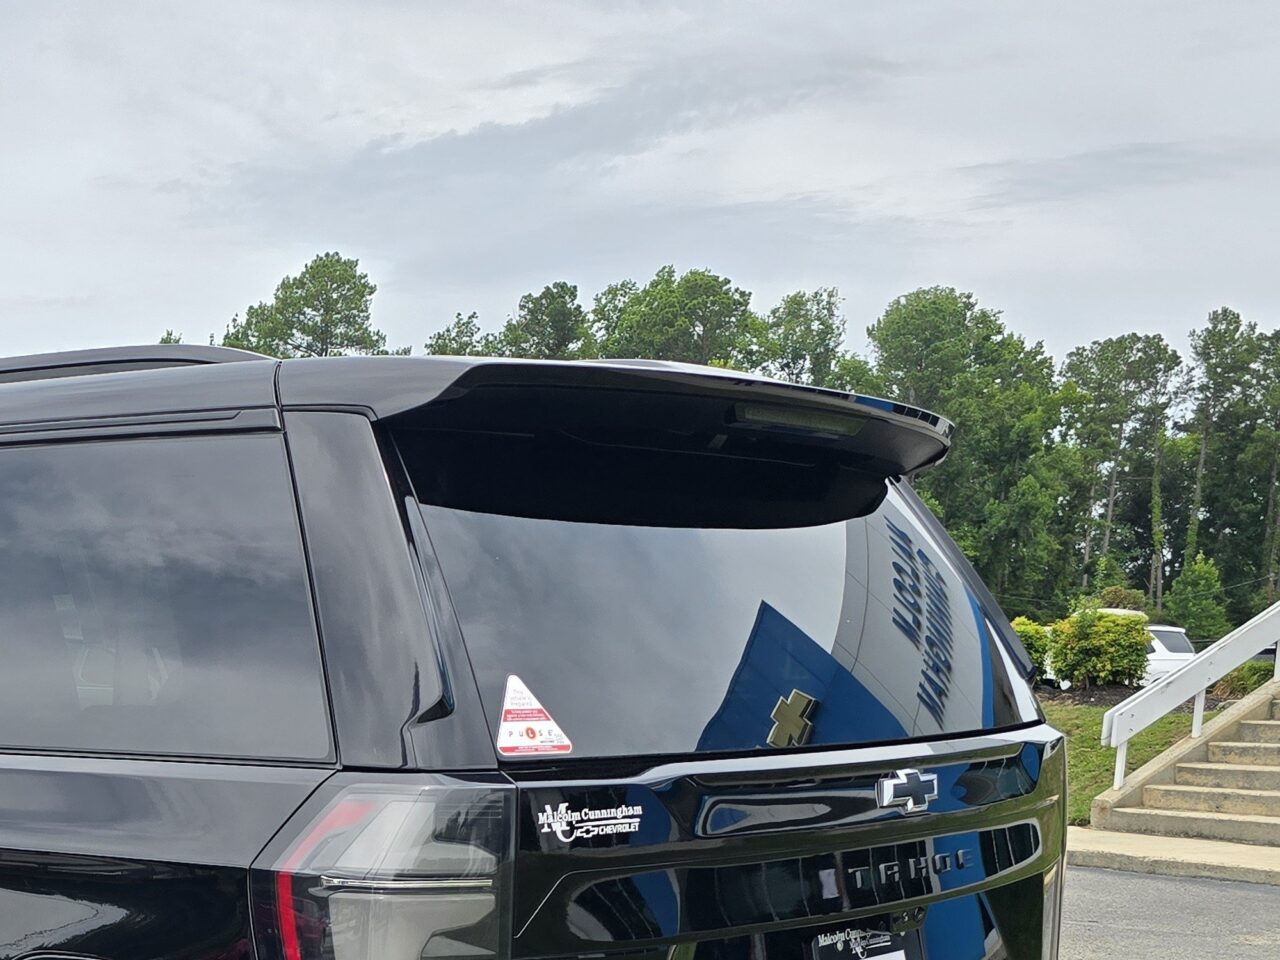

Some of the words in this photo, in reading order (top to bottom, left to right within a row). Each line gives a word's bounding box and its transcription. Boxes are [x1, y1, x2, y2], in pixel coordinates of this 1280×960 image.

[537, 809, 581, 825] Malcolm
[581, 804, 643, 820] Cunningham
[598, 822, 640, 835] CHEVROLET
[847, 849, 974, 888] TAHOE
[817, 930, 846, 948] Malcolm
